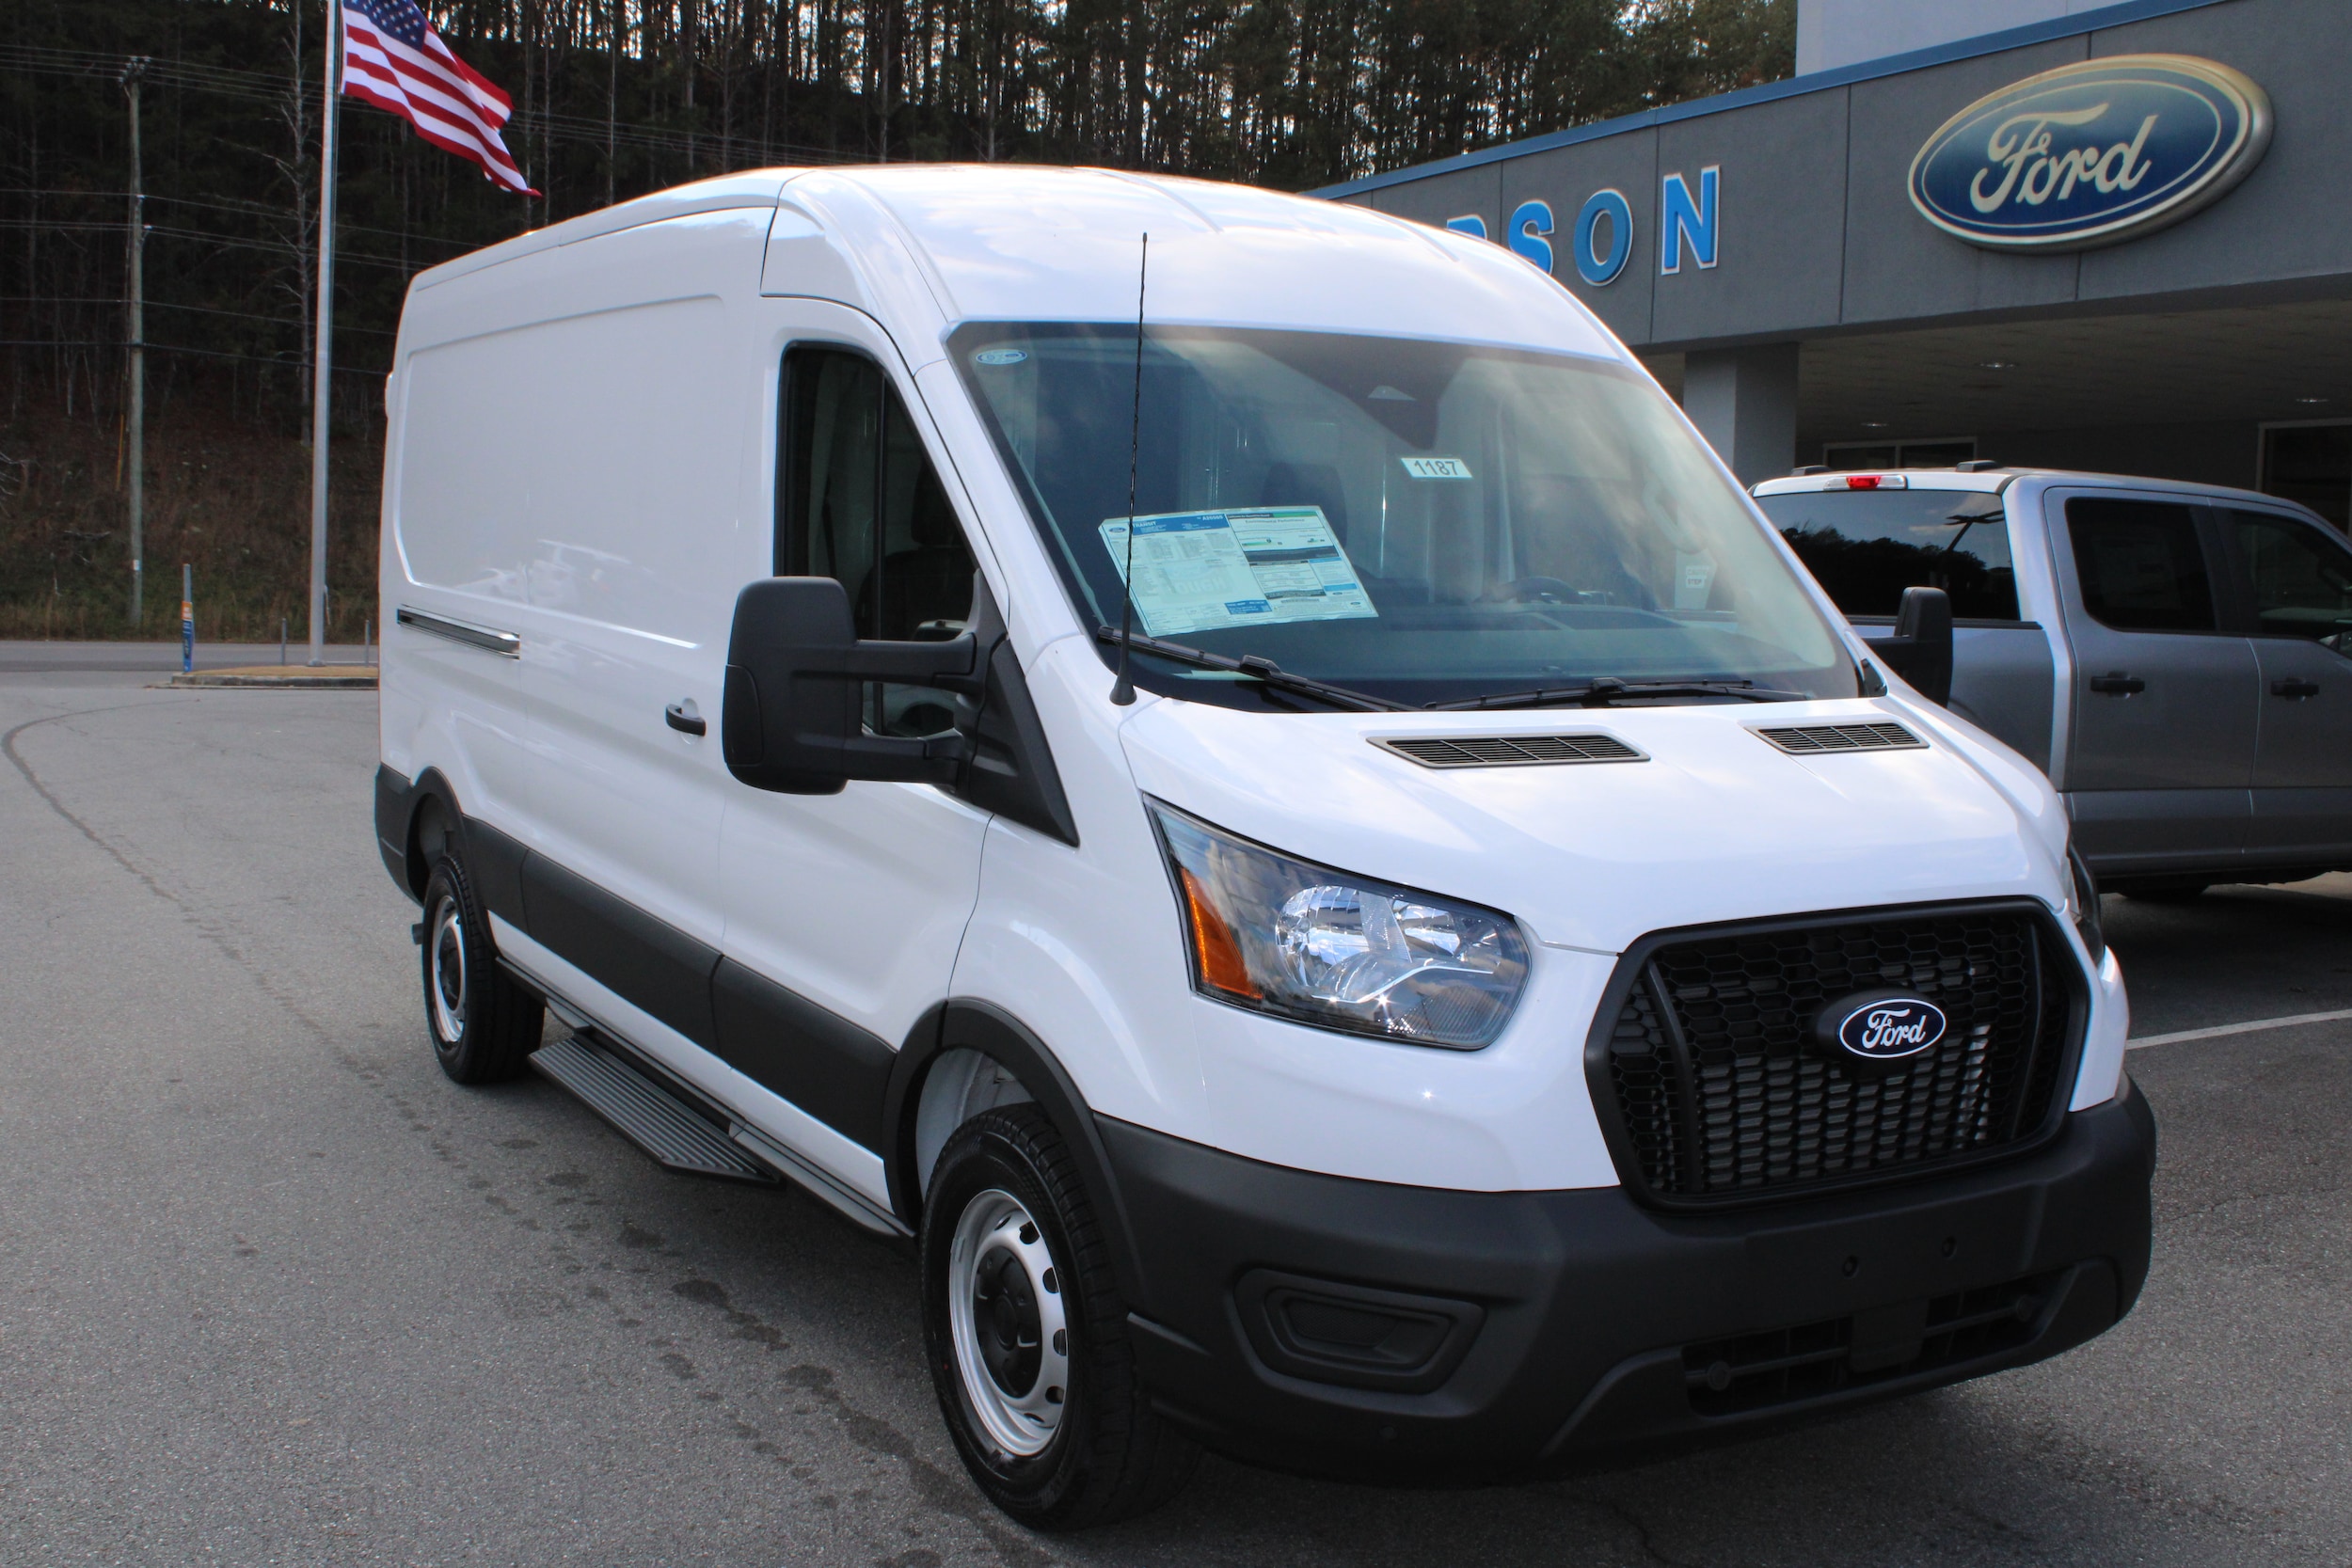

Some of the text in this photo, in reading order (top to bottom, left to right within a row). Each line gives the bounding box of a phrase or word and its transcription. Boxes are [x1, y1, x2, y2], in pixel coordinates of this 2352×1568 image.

[1970, 103, 2159, 214] Ford
[1447, 165, 1721, 287] SON
[1414, 460, 1458, 476] 1187
[1861, 1008, 1928, 1049] Ford
